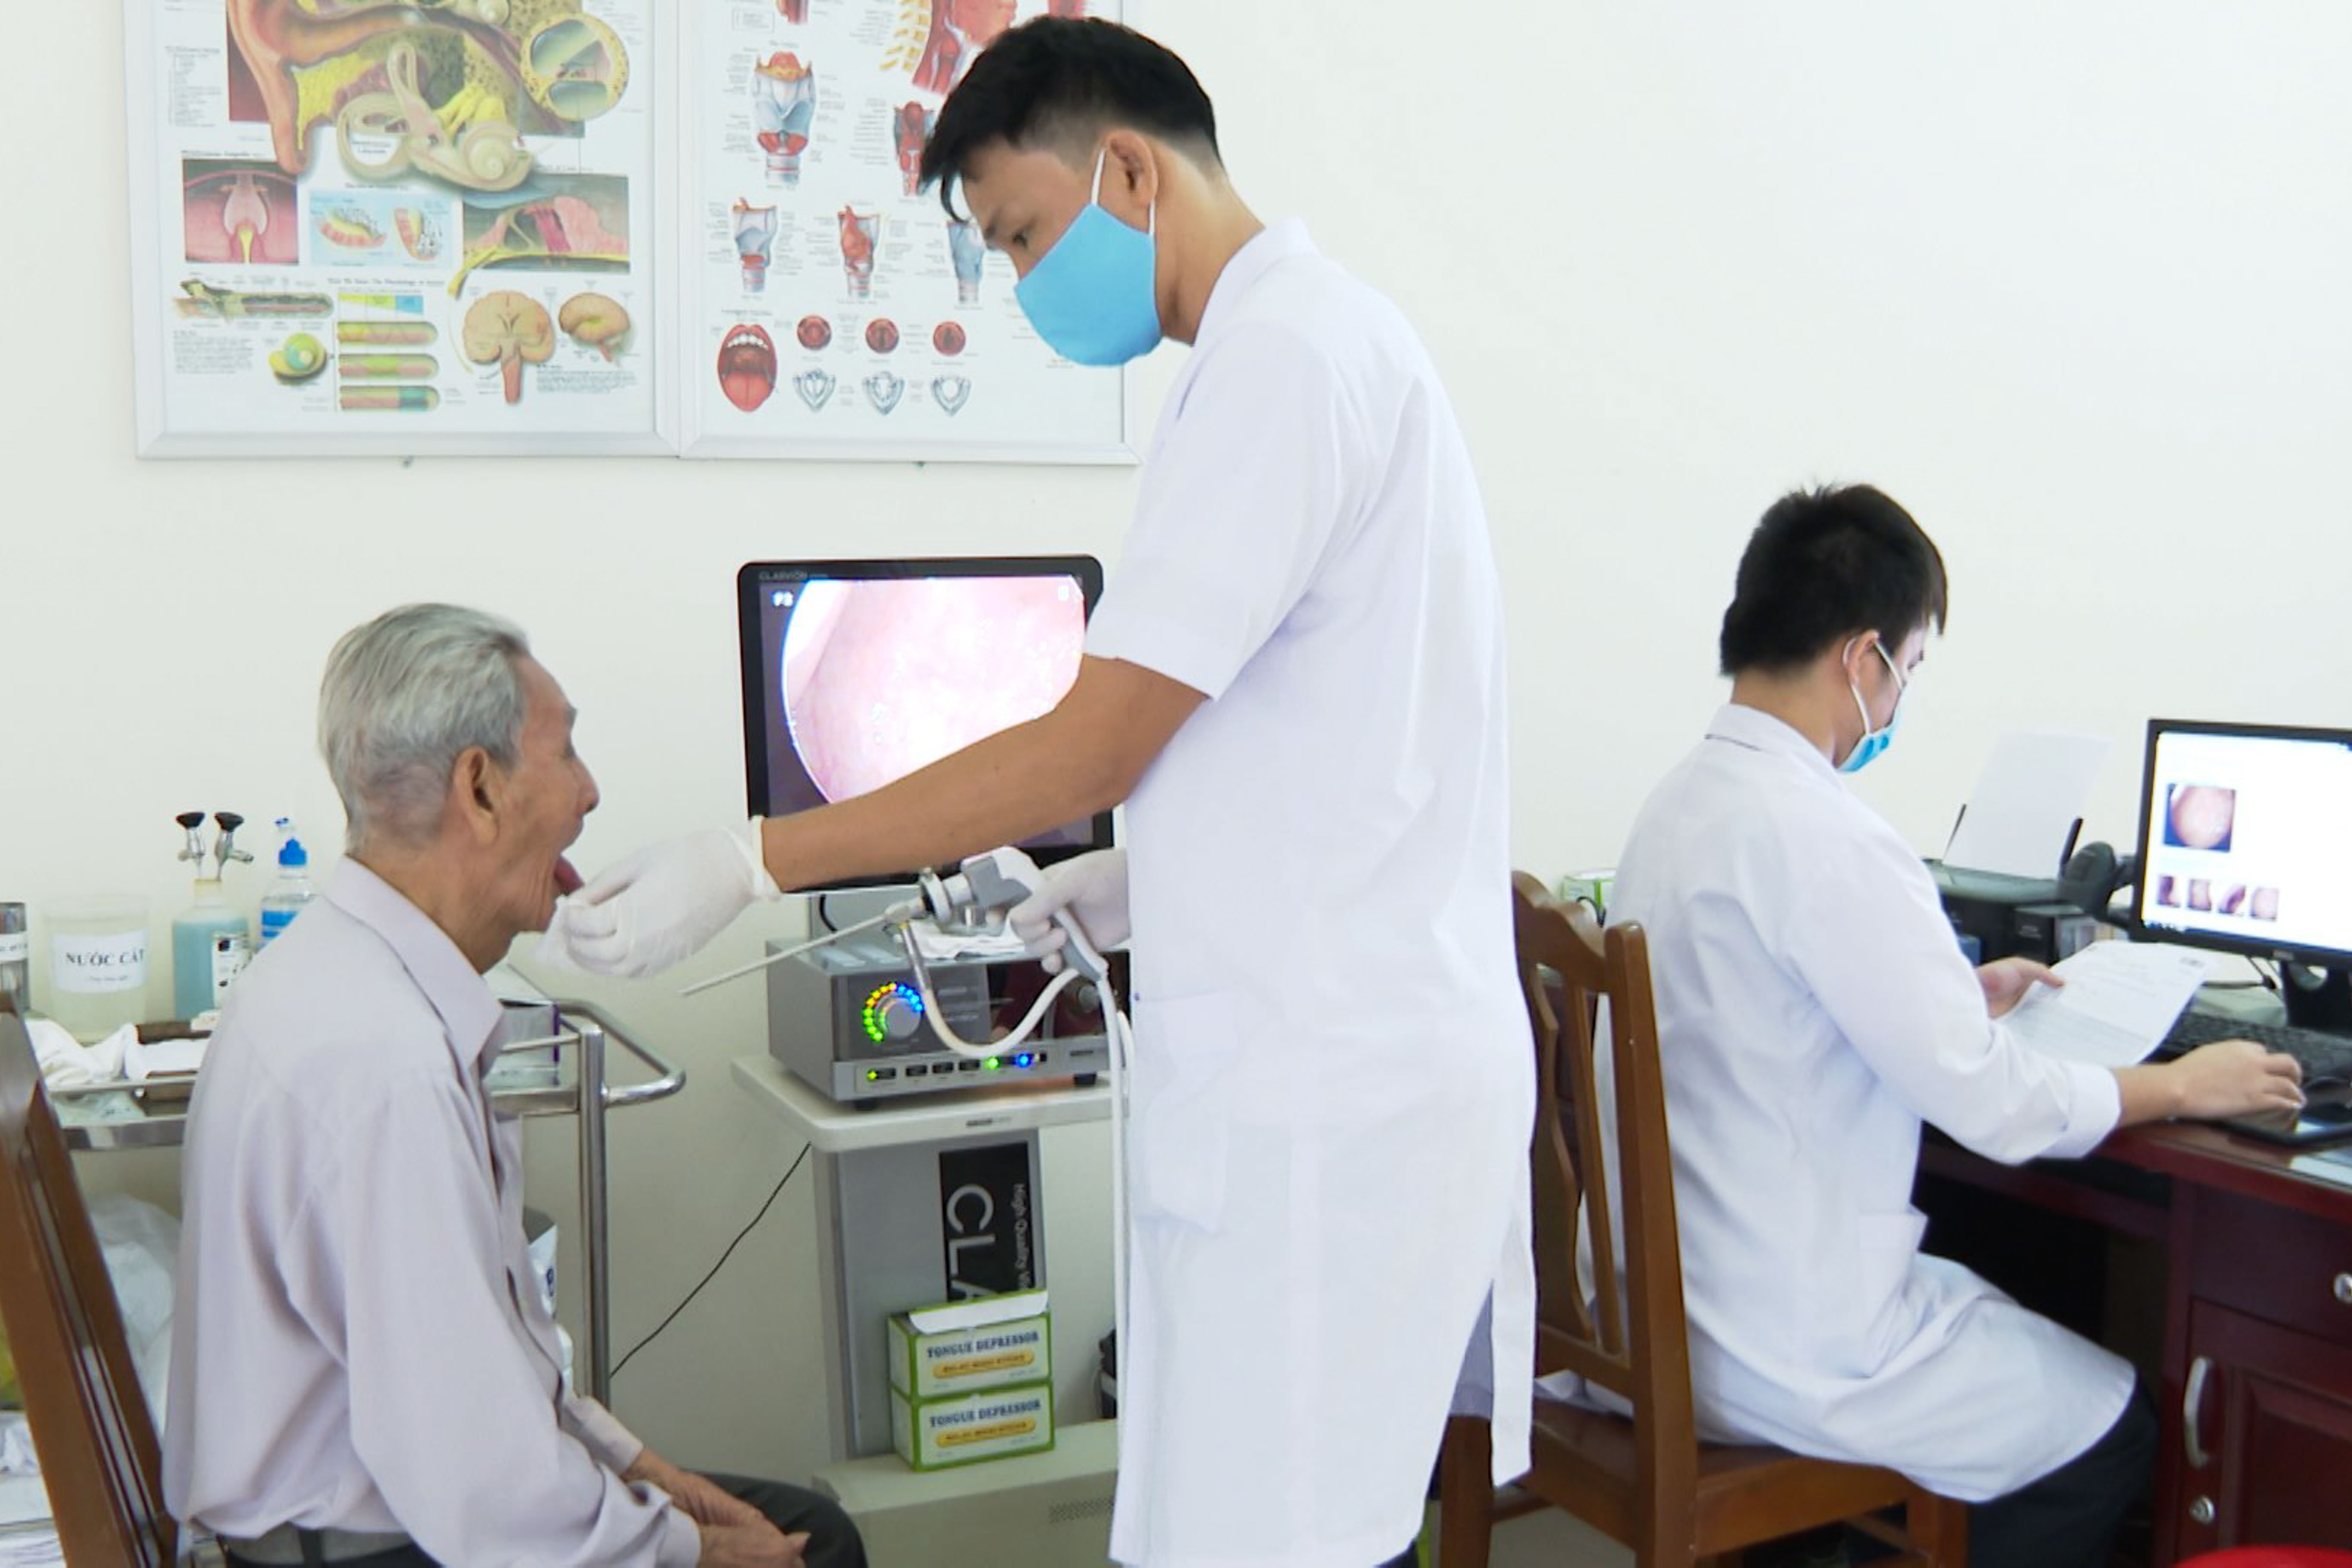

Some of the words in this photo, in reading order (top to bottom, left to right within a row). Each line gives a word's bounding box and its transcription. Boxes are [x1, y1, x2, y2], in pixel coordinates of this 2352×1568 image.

[1011, 1183, 1026, 1217] High
[1013, 1219, 1028, 1269] Quality
[927, 1342, 972, 1358] TONGUE
[977, 1331, 1038, 1350] DEPRESSOR
[930, 1411, 974, 1427] TONGUE
[979, 1399, 1040, 1419] DEPRESSOR
